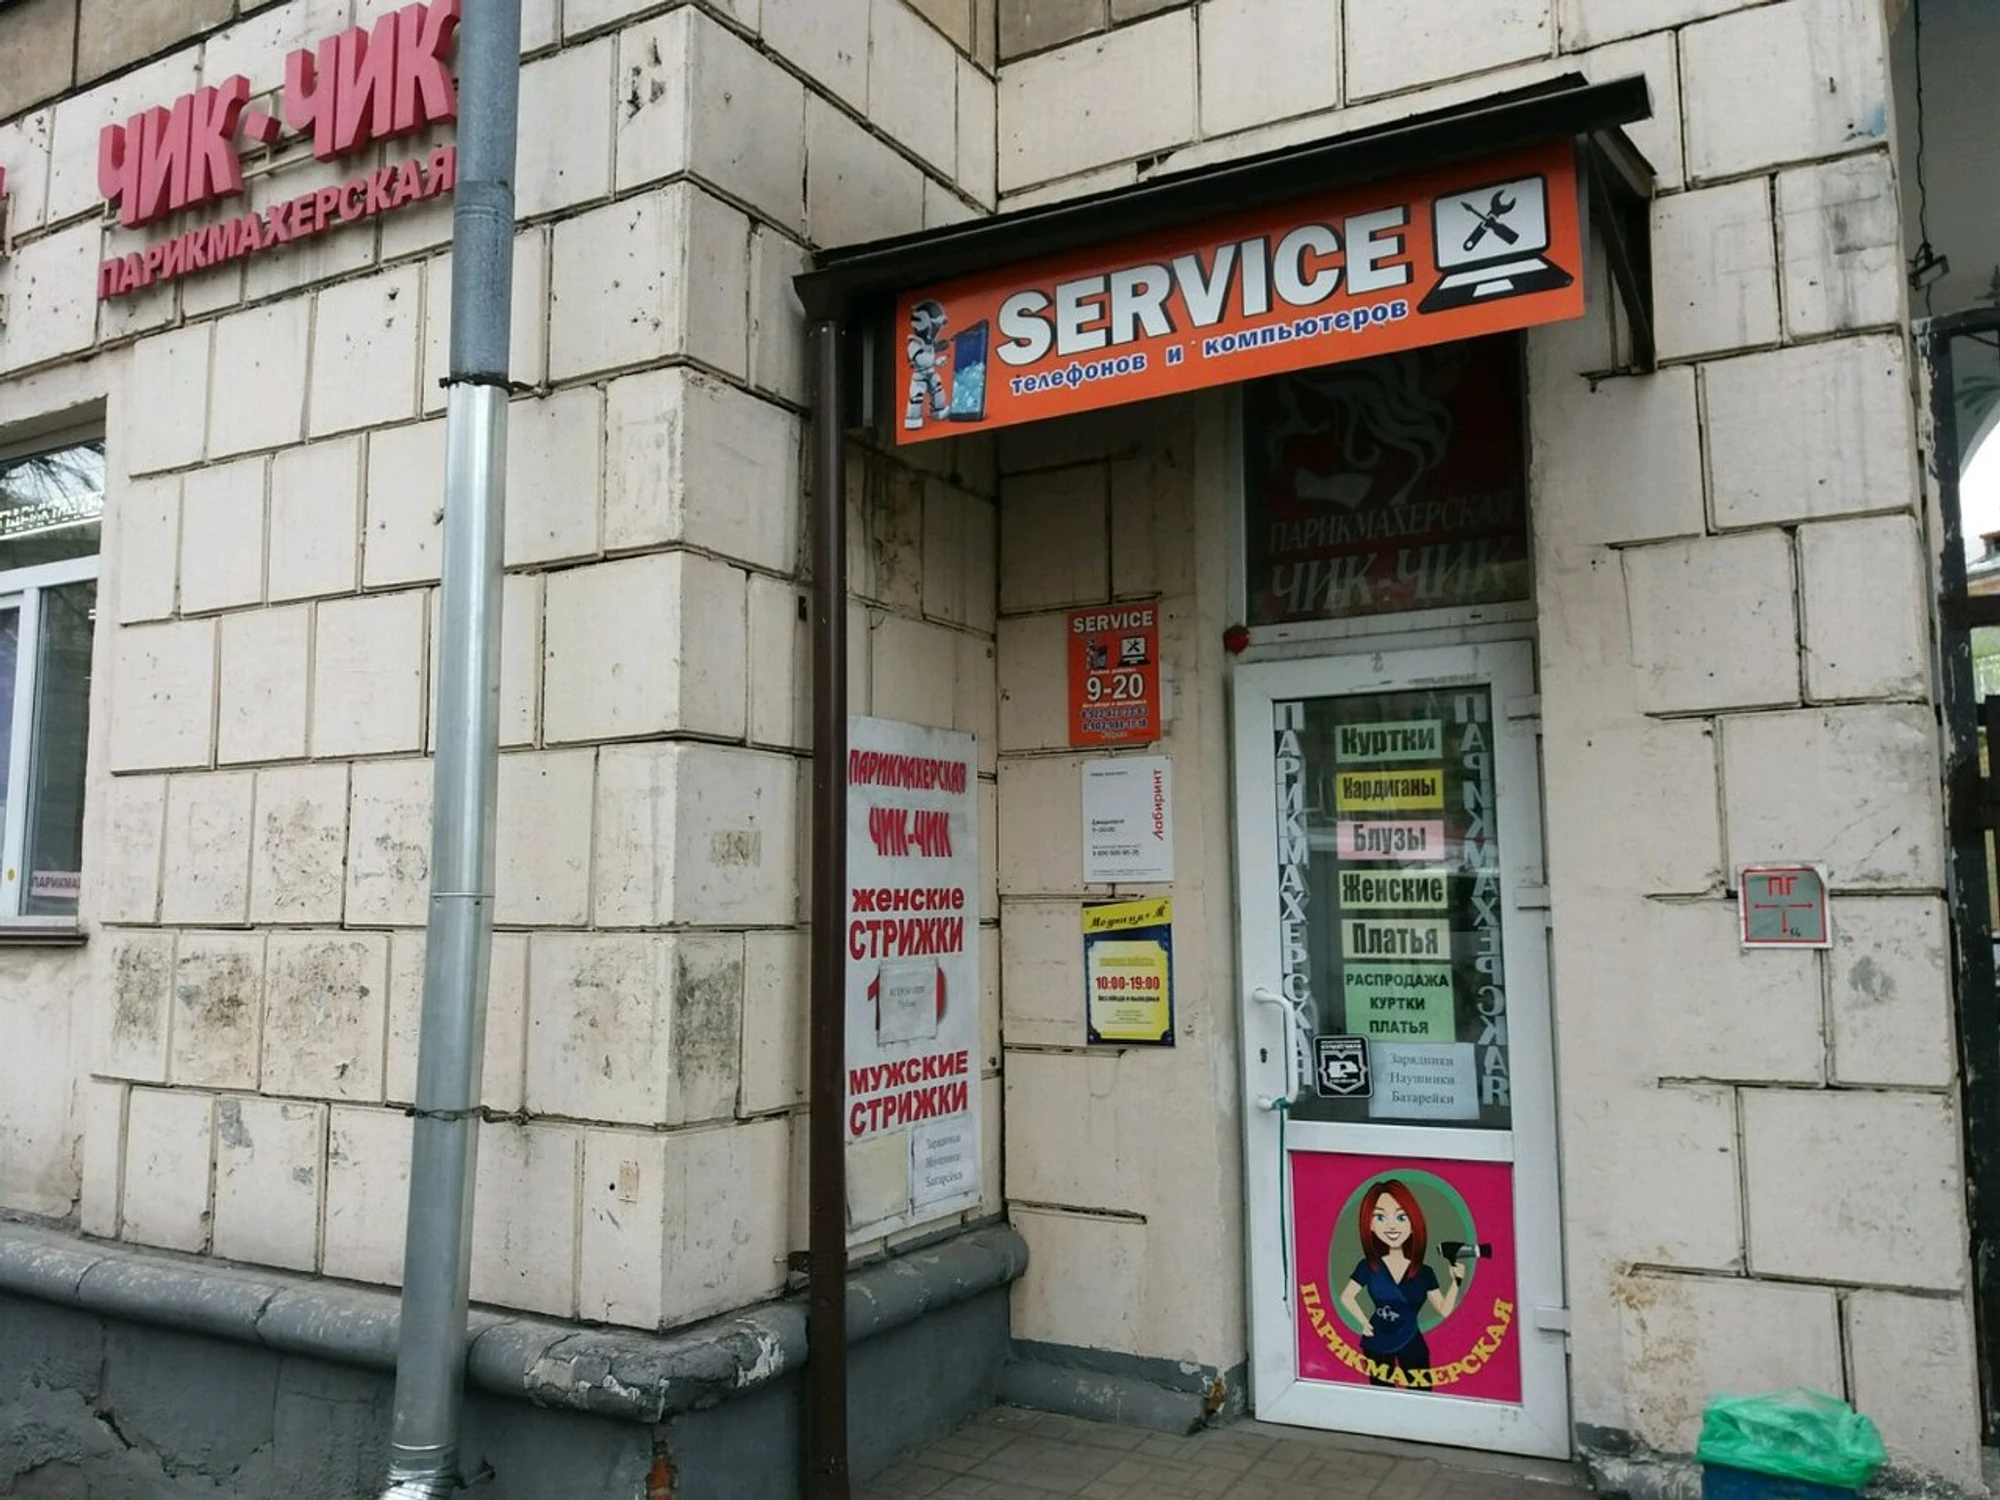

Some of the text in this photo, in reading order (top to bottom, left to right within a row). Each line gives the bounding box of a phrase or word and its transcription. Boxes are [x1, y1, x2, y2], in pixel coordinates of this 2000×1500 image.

[97, 146, 456, 300] ПАРИКМАХЕРСКАЯ
[995, 204, 1414, 366] SERVICE
[1011, 299, 1409, 396] телефонов и компьютеров
[1269, 490, 1513, 552] ПАРИКМАХЕРСКАЯ
[1073, 610, 1154, 633] SERVICE
[1086, 672, 1144, 701] 9-20
[1341, 727, 1436, 757] Куртки
[849, 750, 967, 795] ПАРИКМАХЕРСКАЯ
[1342, 777, 1436, 801] Кардиганы
[1152, 769, 1165, 841] Лабиринт
[868, 807, 953, 858] ЧИК-ЧИК
[1353, 823, 1426, 855] Блузы
[852, 888, 965, 913] женские
[1342, 873, 1444, 904] Женские
[1768, 876, 1799, 896] ПГ
[850, 916, 964, 961] СТРИЖКИ
[1352, 923, 1439, 955] Платья
[1095, 976, 1160, 991] 10:00-19:00
[1346, 973, 1450, 988] РАСПРОДАЖА
[1370, 997, 1425, 1011] КУРТКИ
[1369, 1020, 1430, 1035] ПЛАТЬЯ
[849, 1051, 969, 1096] МУЖСКИЕ
[1389, 1051, 1454, 1067] Зарядники
[1389, 1073, 1455, 1088] Наушники
[849, 1080, 968, 1137] СТРИЖКИ
[1391, 1090, 1455, 1106] Батарейки
[1300, 1282, 1514, 1387] ПАРИКМАХЕРСКАЯ
